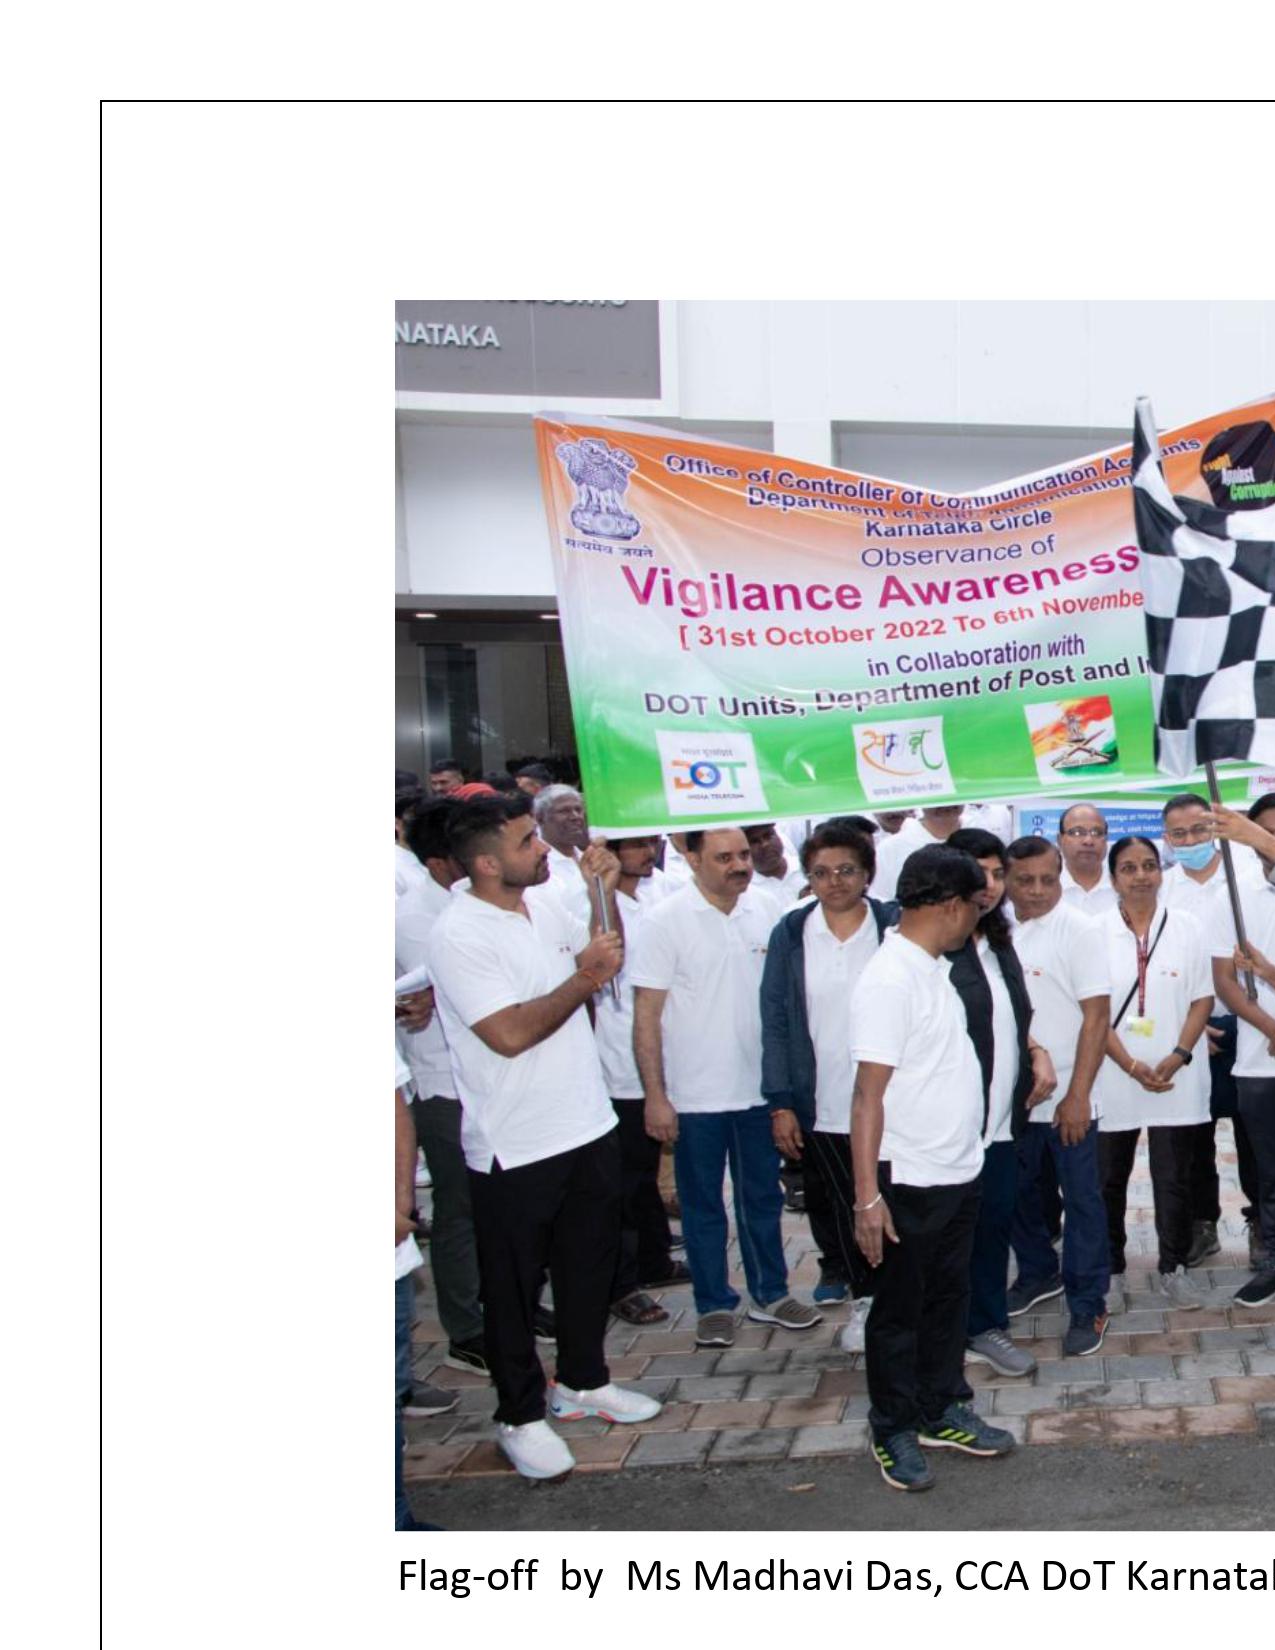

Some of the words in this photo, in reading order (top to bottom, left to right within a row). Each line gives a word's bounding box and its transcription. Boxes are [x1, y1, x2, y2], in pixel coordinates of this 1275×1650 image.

[665, 454, 739, 479] Office
[747, 469, 772, 485] of
[778, 472, 895, 503] Controller
[866, 518, 982, 538] Karnataka
[990, 510, 1053, 532] Circle
[861, 543, 1022, 568] Observance
[1031, 534, 1056, 555] of
[621, 565, 861, 618] Vigilance
[879, 545, 1141, 608] Awareness
[698, 624, 757, 647] 31st
[765, 625, 875, 647] October
[884, 618, 947, 640] 2022
[954, 615, 986, 633] To
[994, 606, 1035, 625] 6th
[867, 658, 890, 677] in
[896, 640, 1042, 673] Collaboration
[1047, 632, 1085, 658] with
[644, 692, 708, 716] DOT
[719, 695, 806, 718] Units,
[815, 676, 981, 712] Department
[988, 671, 1012, 693] of
[1019, 665, 1076, 689] Post
[1083, 656, 1131, 681] and
